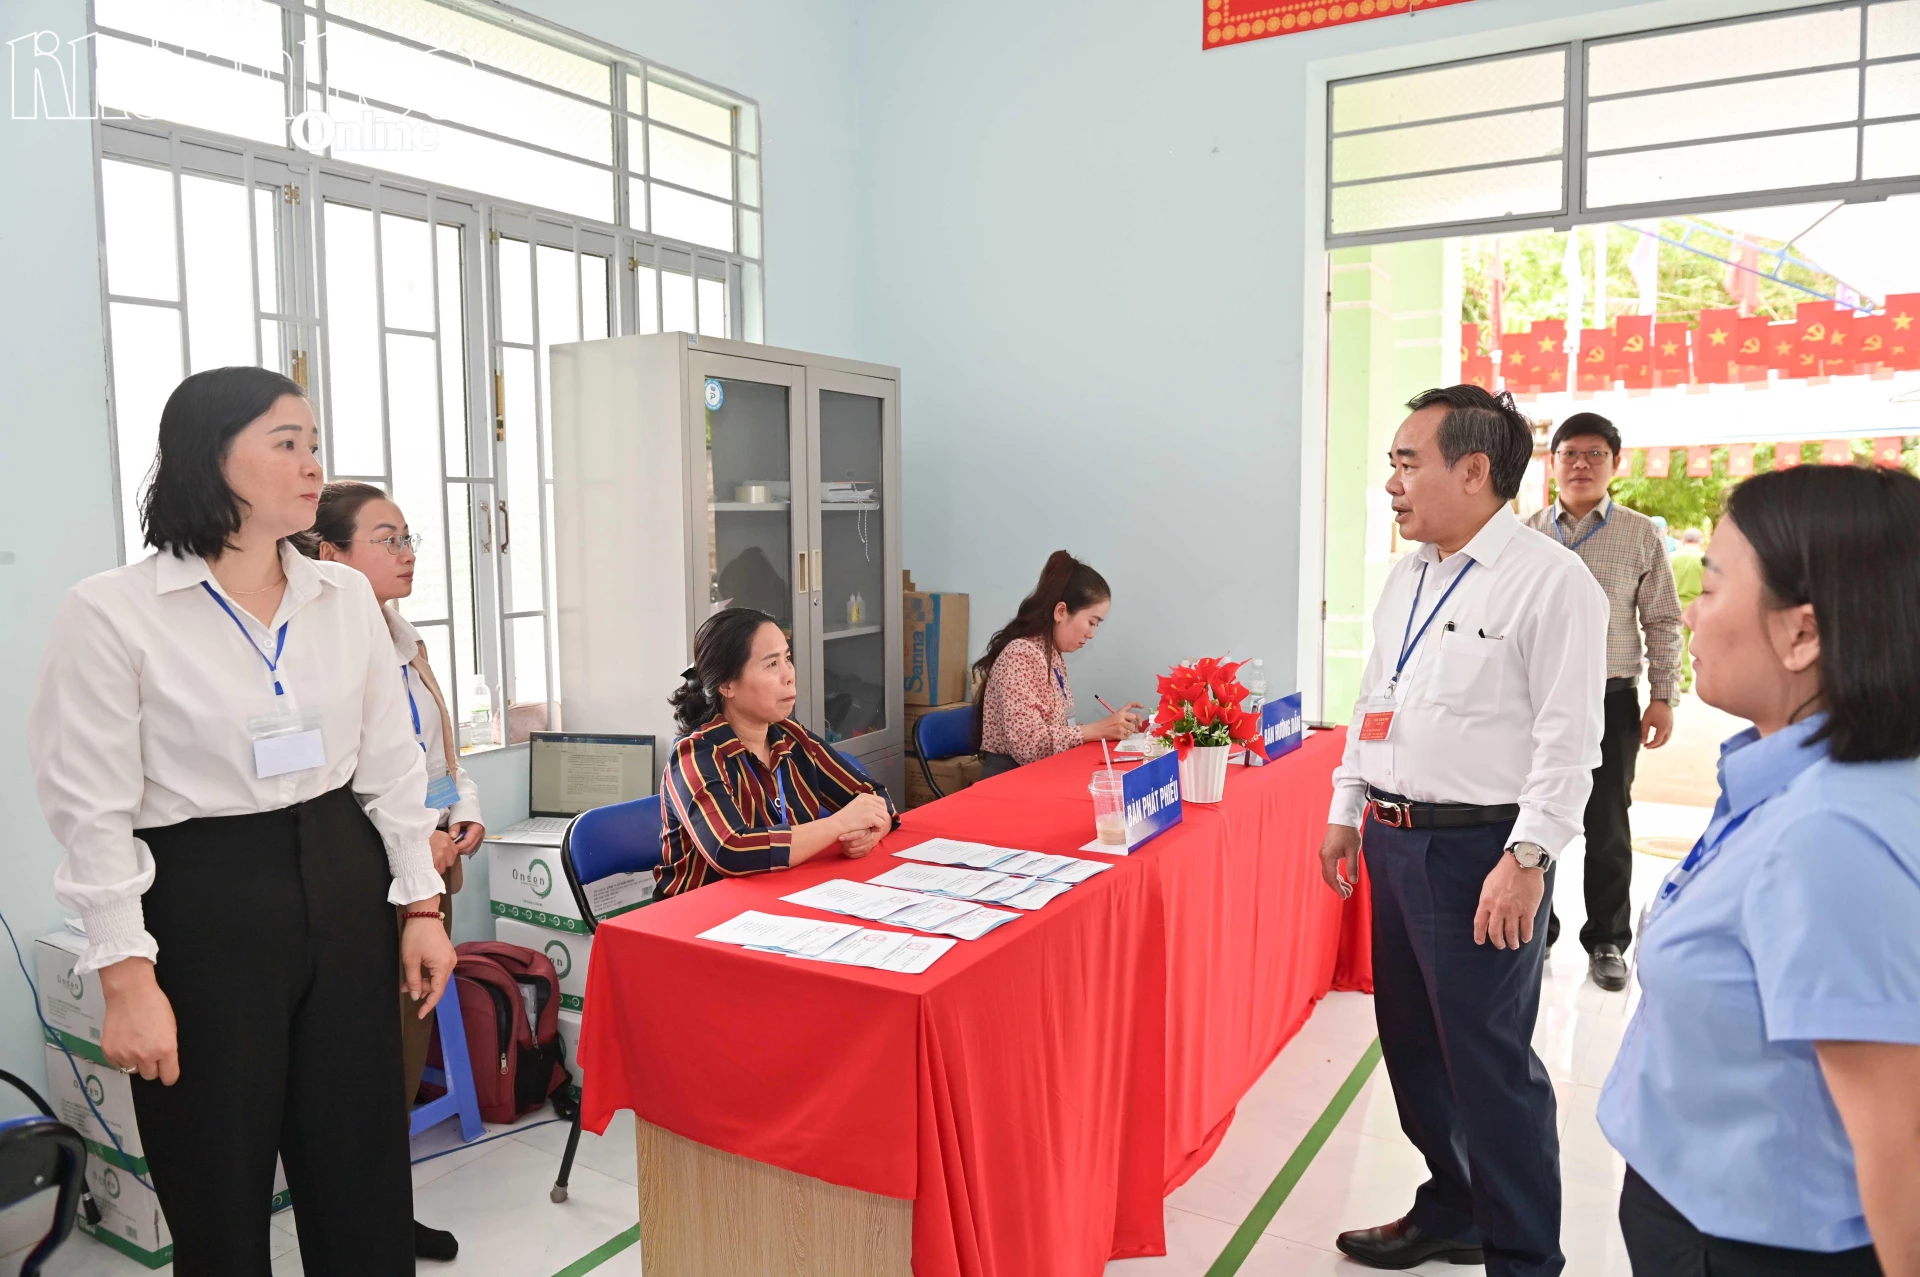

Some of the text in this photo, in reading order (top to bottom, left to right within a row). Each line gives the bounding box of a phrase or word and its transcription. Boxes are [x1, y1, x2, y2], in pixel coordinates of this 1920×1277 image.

[903, 630, 925, 693] Sanna
[1127, 774, 1179, 828] BÀN PHÁT PHIẾU
[512, 868, 545, 886] Onsen
